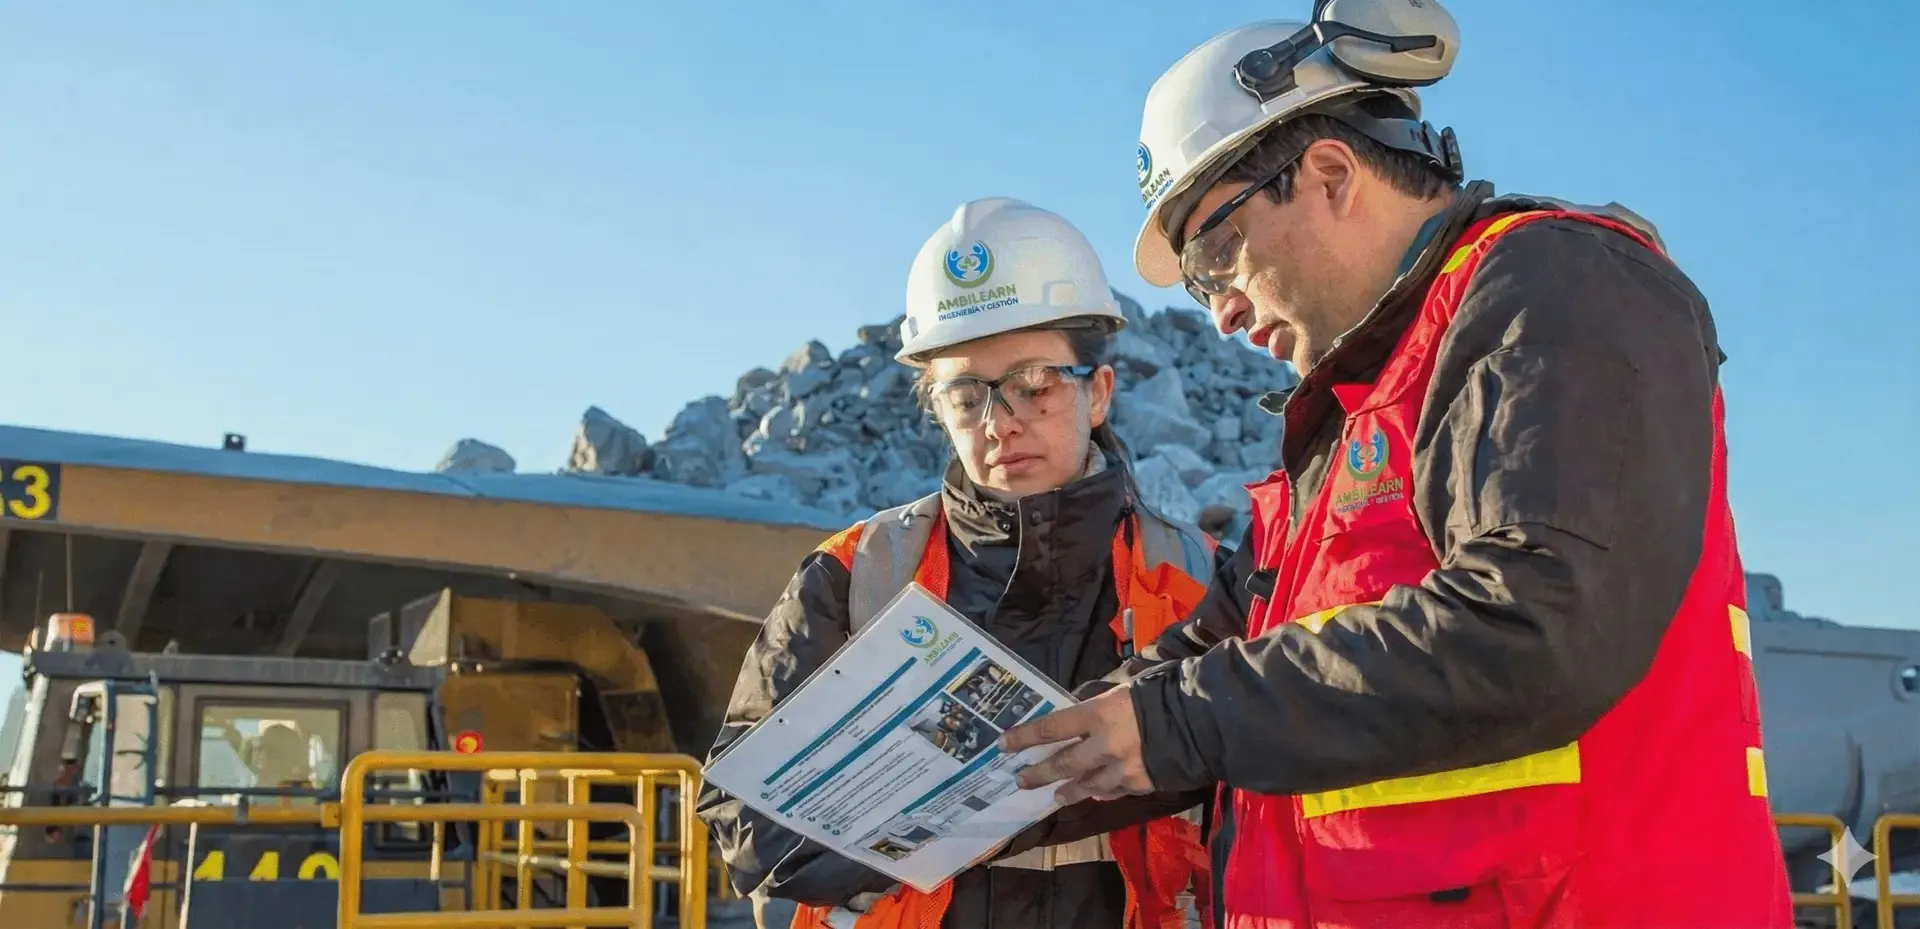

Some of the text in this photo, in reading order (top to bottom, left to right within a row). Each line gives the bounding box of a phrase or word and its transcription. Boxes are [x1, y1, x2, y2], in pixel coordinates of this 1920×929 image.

[937, 284, 1017, 312] AMBILEARN
[938, 296, 1019, 321] INGENIERÍA Y GESTIÓN
[0, 464, 52, 520] 3
[1335, 477, 1404, 505] AMBILEARN
